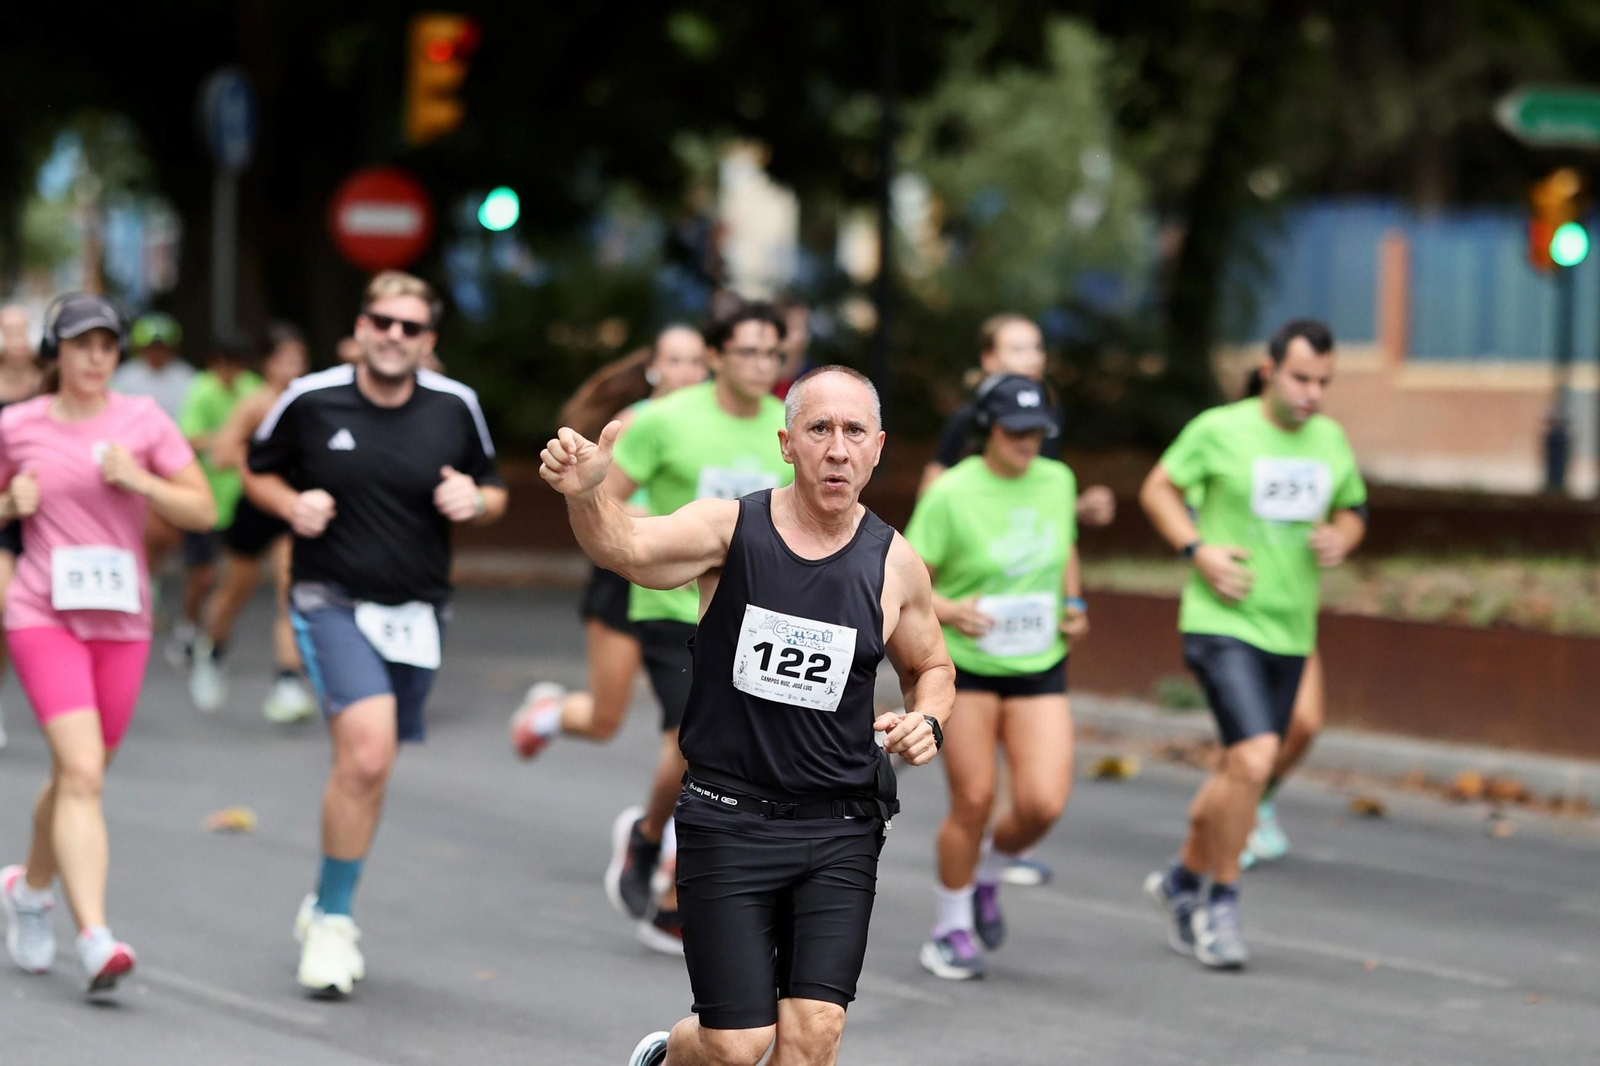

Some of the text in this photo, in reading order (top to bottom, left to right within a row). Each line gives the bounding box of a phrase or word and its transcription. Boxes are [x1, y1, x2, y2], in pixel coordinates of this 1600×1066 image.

[67, 566, 125, 593] 915
[753, 641, 832, 684] 122
[760, 675, 780, 685] CAMPOS
[803, 684, 813, 692] LUIS
